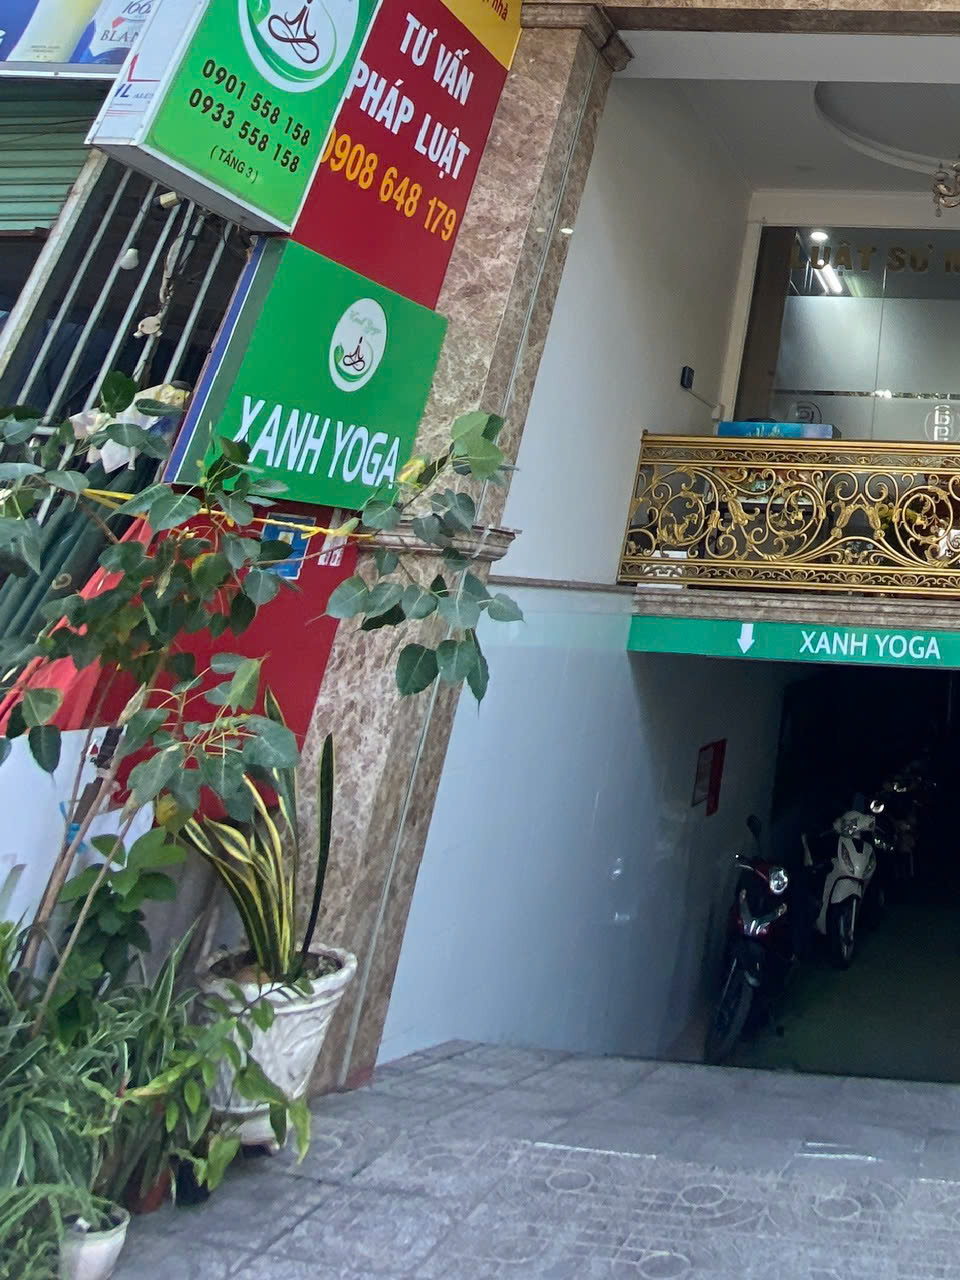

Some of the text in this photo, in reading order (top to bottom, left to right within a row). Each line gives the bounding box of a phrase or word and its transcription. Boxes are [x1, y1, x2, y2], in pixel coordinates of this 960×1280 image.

[121, 0, 152, 14] 166
[399, 12, 475, 106] TƯ VẤN
[189, 88, 235, 129] 0933
[238, 120, 269, 152] 558
[273, 143, 300, 172] 158
[202, 59, 310, 146] 0901 558 158
[345, 58, 471, 180] PHÁP LUẬT
[379, 167, 422, 218] 648
[424, 196, 457, 241] 179
[233, 395, 400, 489] XANH YOGA
[799, 630, 941, 660] XANH YOGA
